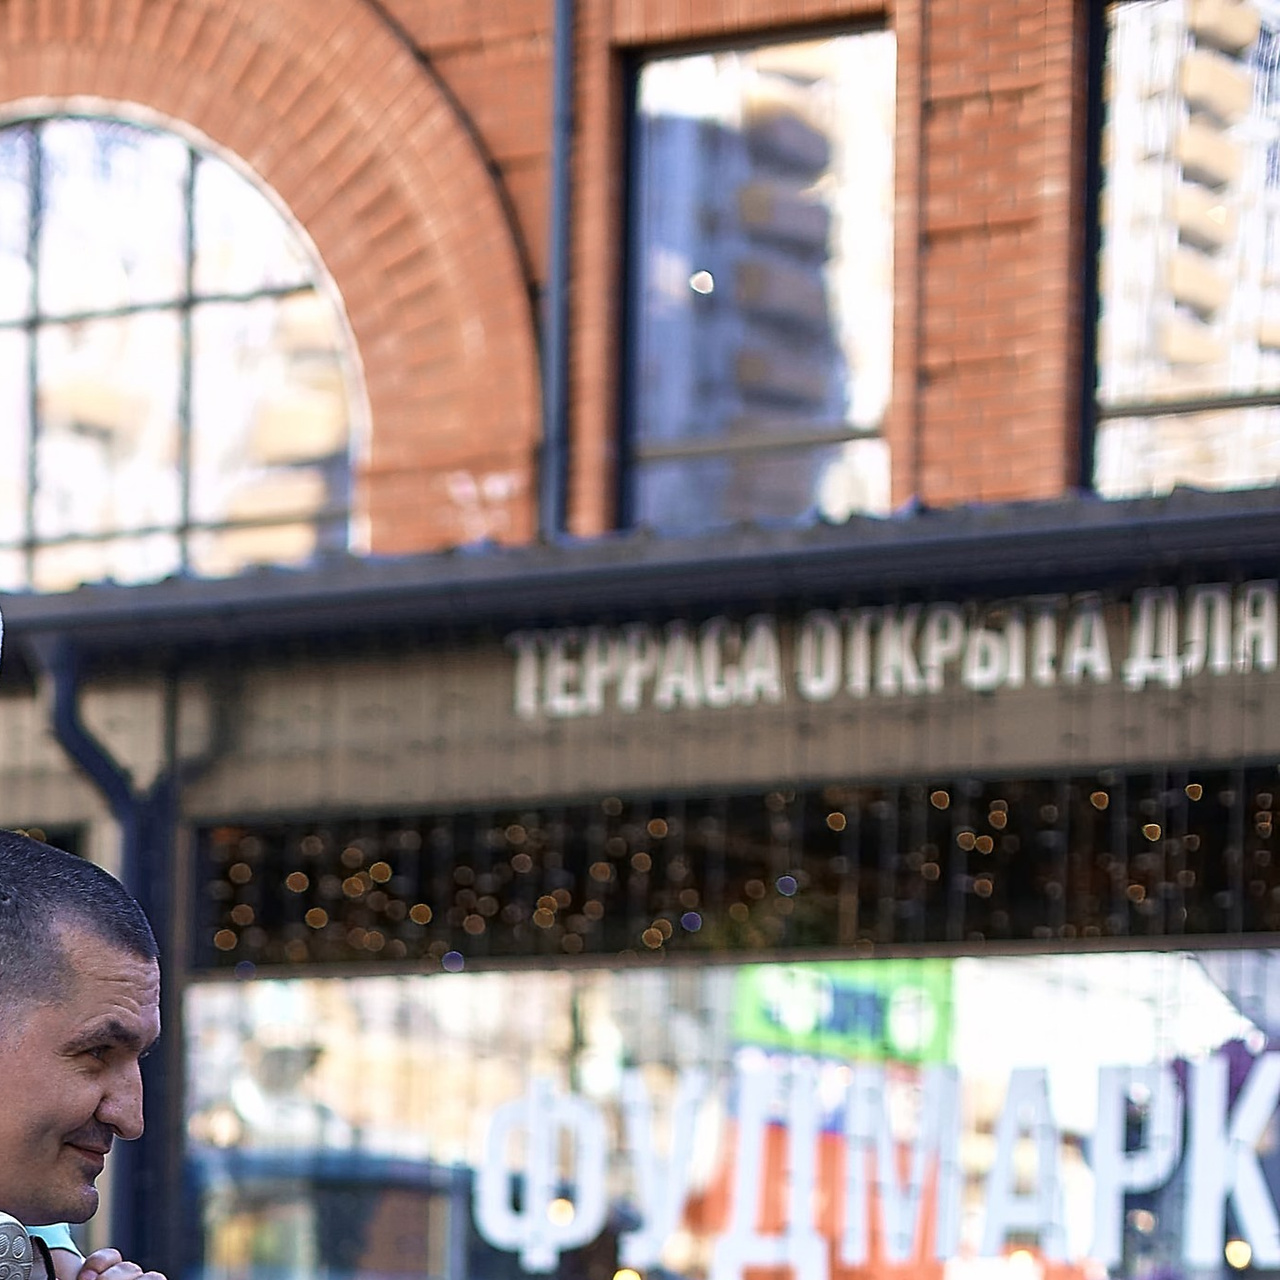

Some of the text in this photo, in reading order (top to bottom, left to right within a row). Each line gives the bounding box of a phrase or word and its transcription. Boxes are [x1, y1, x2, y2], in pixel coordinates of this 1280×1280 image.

[508, 578, 1278, 718] ТЕРРАСА ОТКРЫТА ДЛЯ
